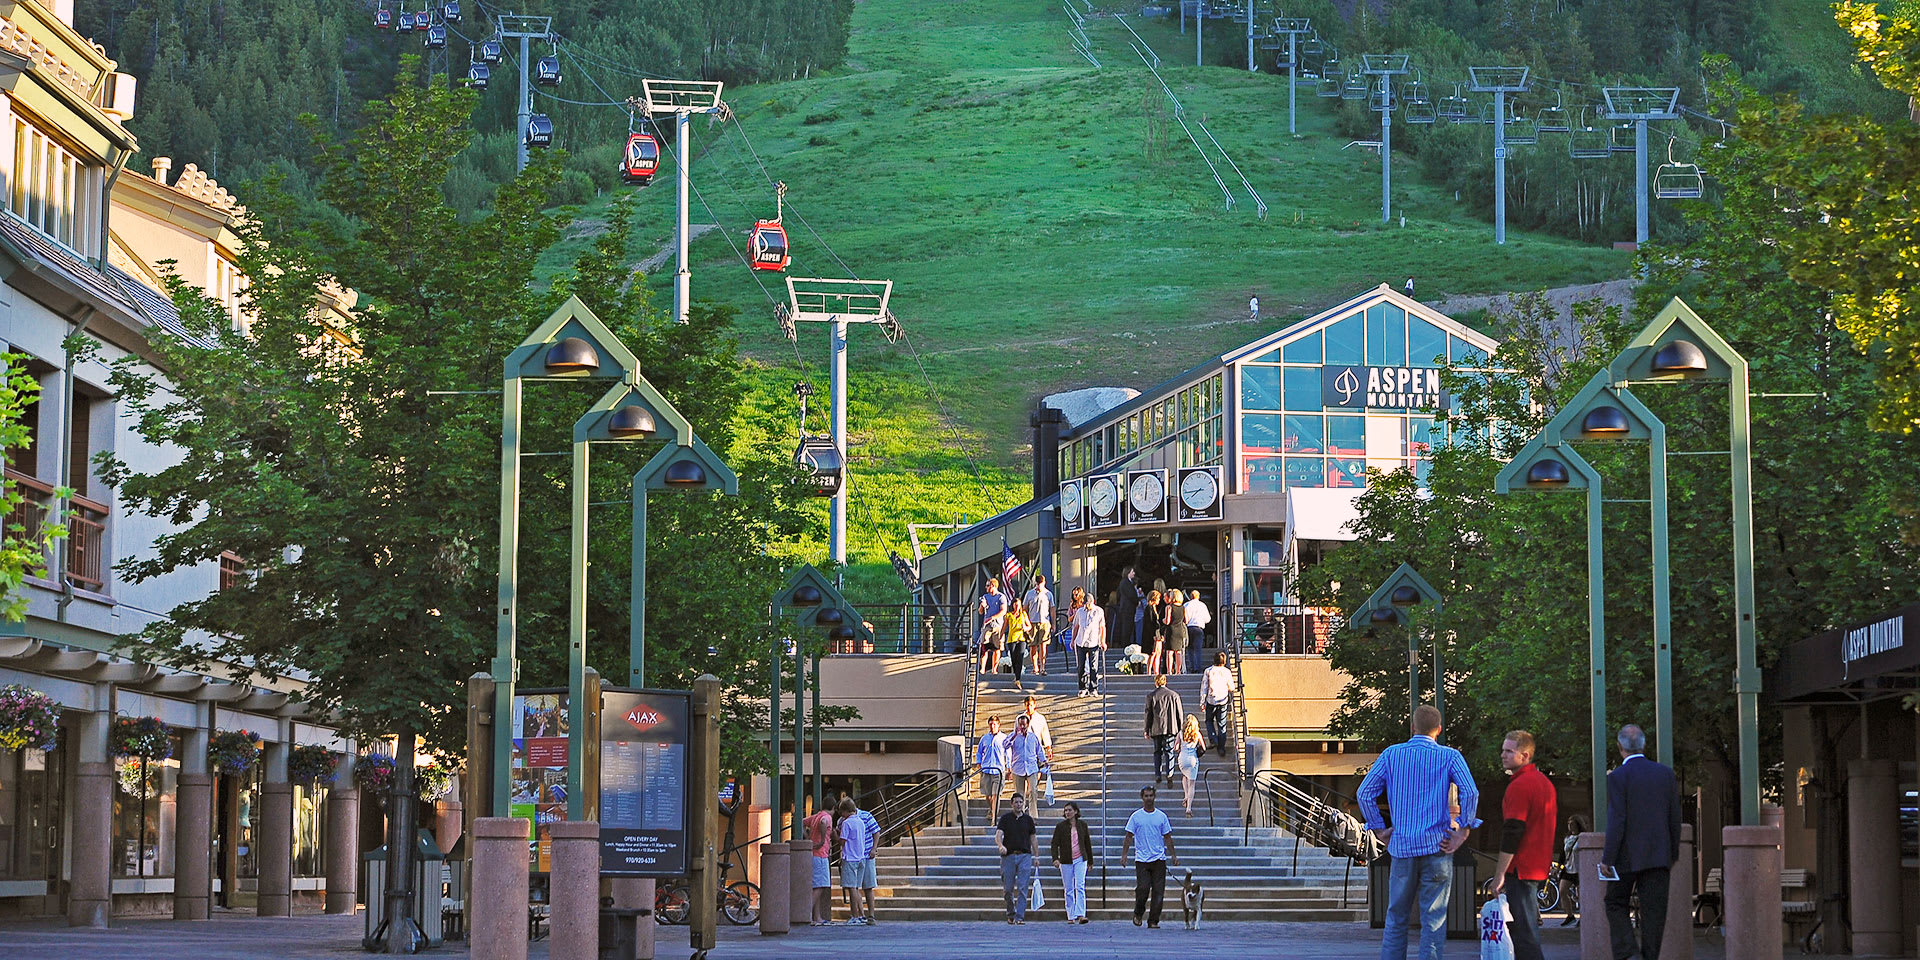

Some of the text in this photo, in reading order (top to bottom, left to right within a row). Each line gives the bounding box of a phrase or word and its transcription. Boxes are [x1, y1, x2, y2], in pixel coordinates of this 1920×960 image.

[635, 160, 653, 168] ASPEN
[760, 253, 780, 261] ASPEN
[1367, 367, 1440, 394] ASPEN
[1849, 616, 1903, 661] ASPEN MOUNTAIN
[628, 711, 658, 722] AJAX
